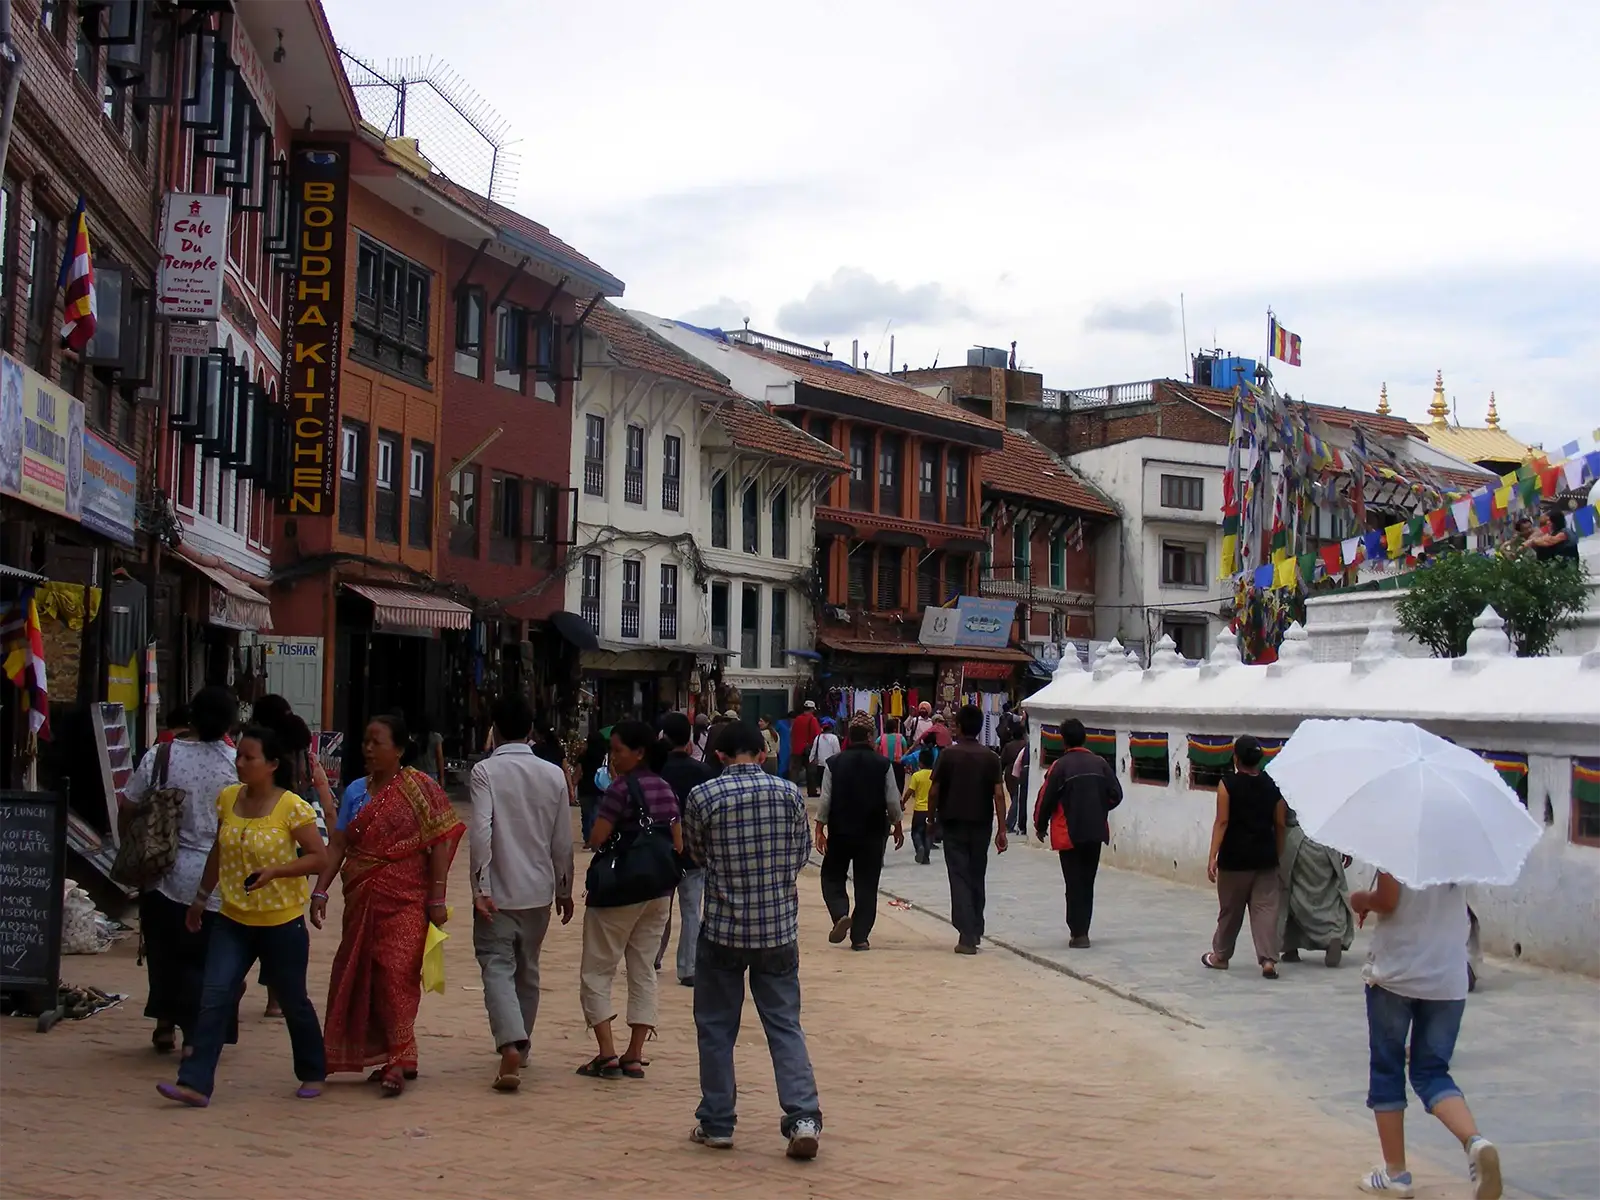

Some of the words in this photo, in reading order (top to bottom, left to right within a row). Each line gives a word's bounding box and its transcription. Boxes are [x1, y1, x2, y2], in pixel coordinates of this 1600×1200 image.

[173, 220, 212, 238] Cafe
[181, 238, 202, 253] Du
[296, 181, 335, 326] BOUDHA
[164, 254, 218, 273] Temple
[286, 304, 295, 348] DINING
[283, 353, 293, 410] GALLERY
[291, 342, 326, 513] KITCHEN
[325, 450, 333, 496] KITCHEN
[14, 807, 47, 818] LUNCH
[19, 841, 52, 853] LATTE
[21, 865, 46, 878] DISH
[2, 895, 33, 907] MORE
